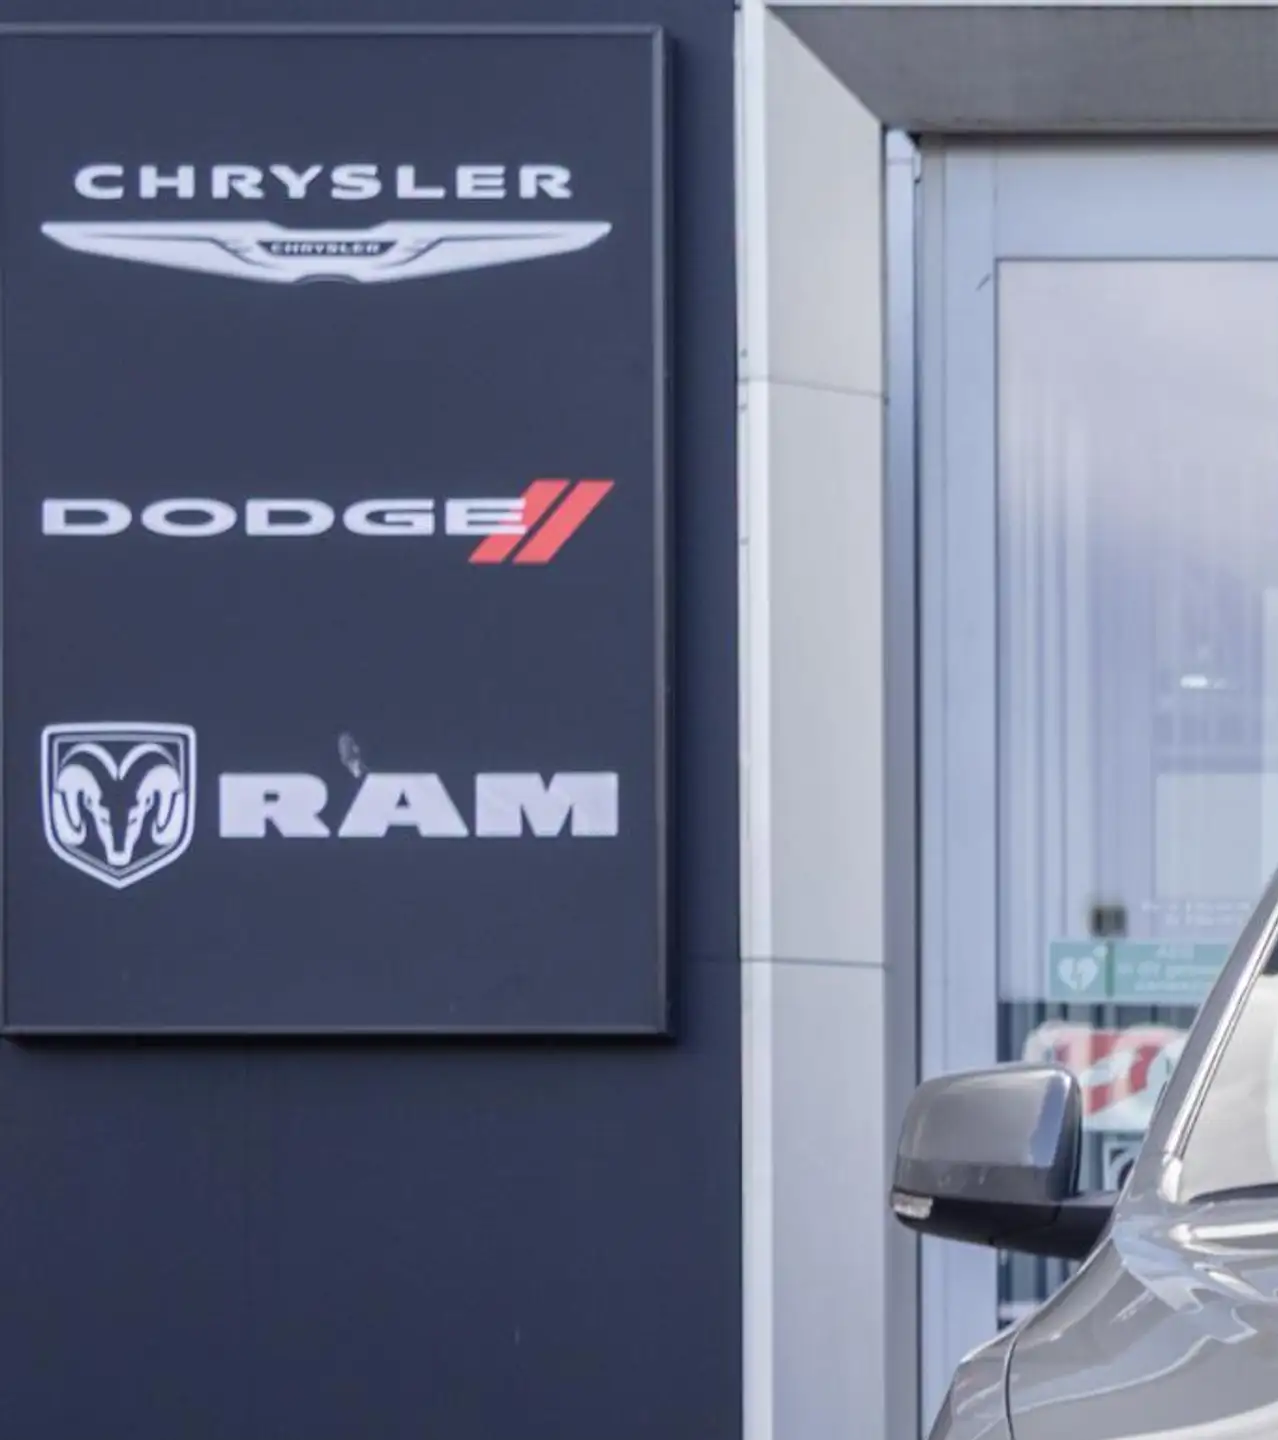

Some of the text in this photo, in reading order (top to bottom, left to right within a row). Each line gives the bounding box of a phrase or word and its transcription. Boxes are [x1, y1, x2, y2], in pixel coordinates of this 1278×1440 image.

[74, 164, 572, 200] CHRYSLER
[42, 498, 527, 537] DODGE
[218, 772, 619, 838] RAM
